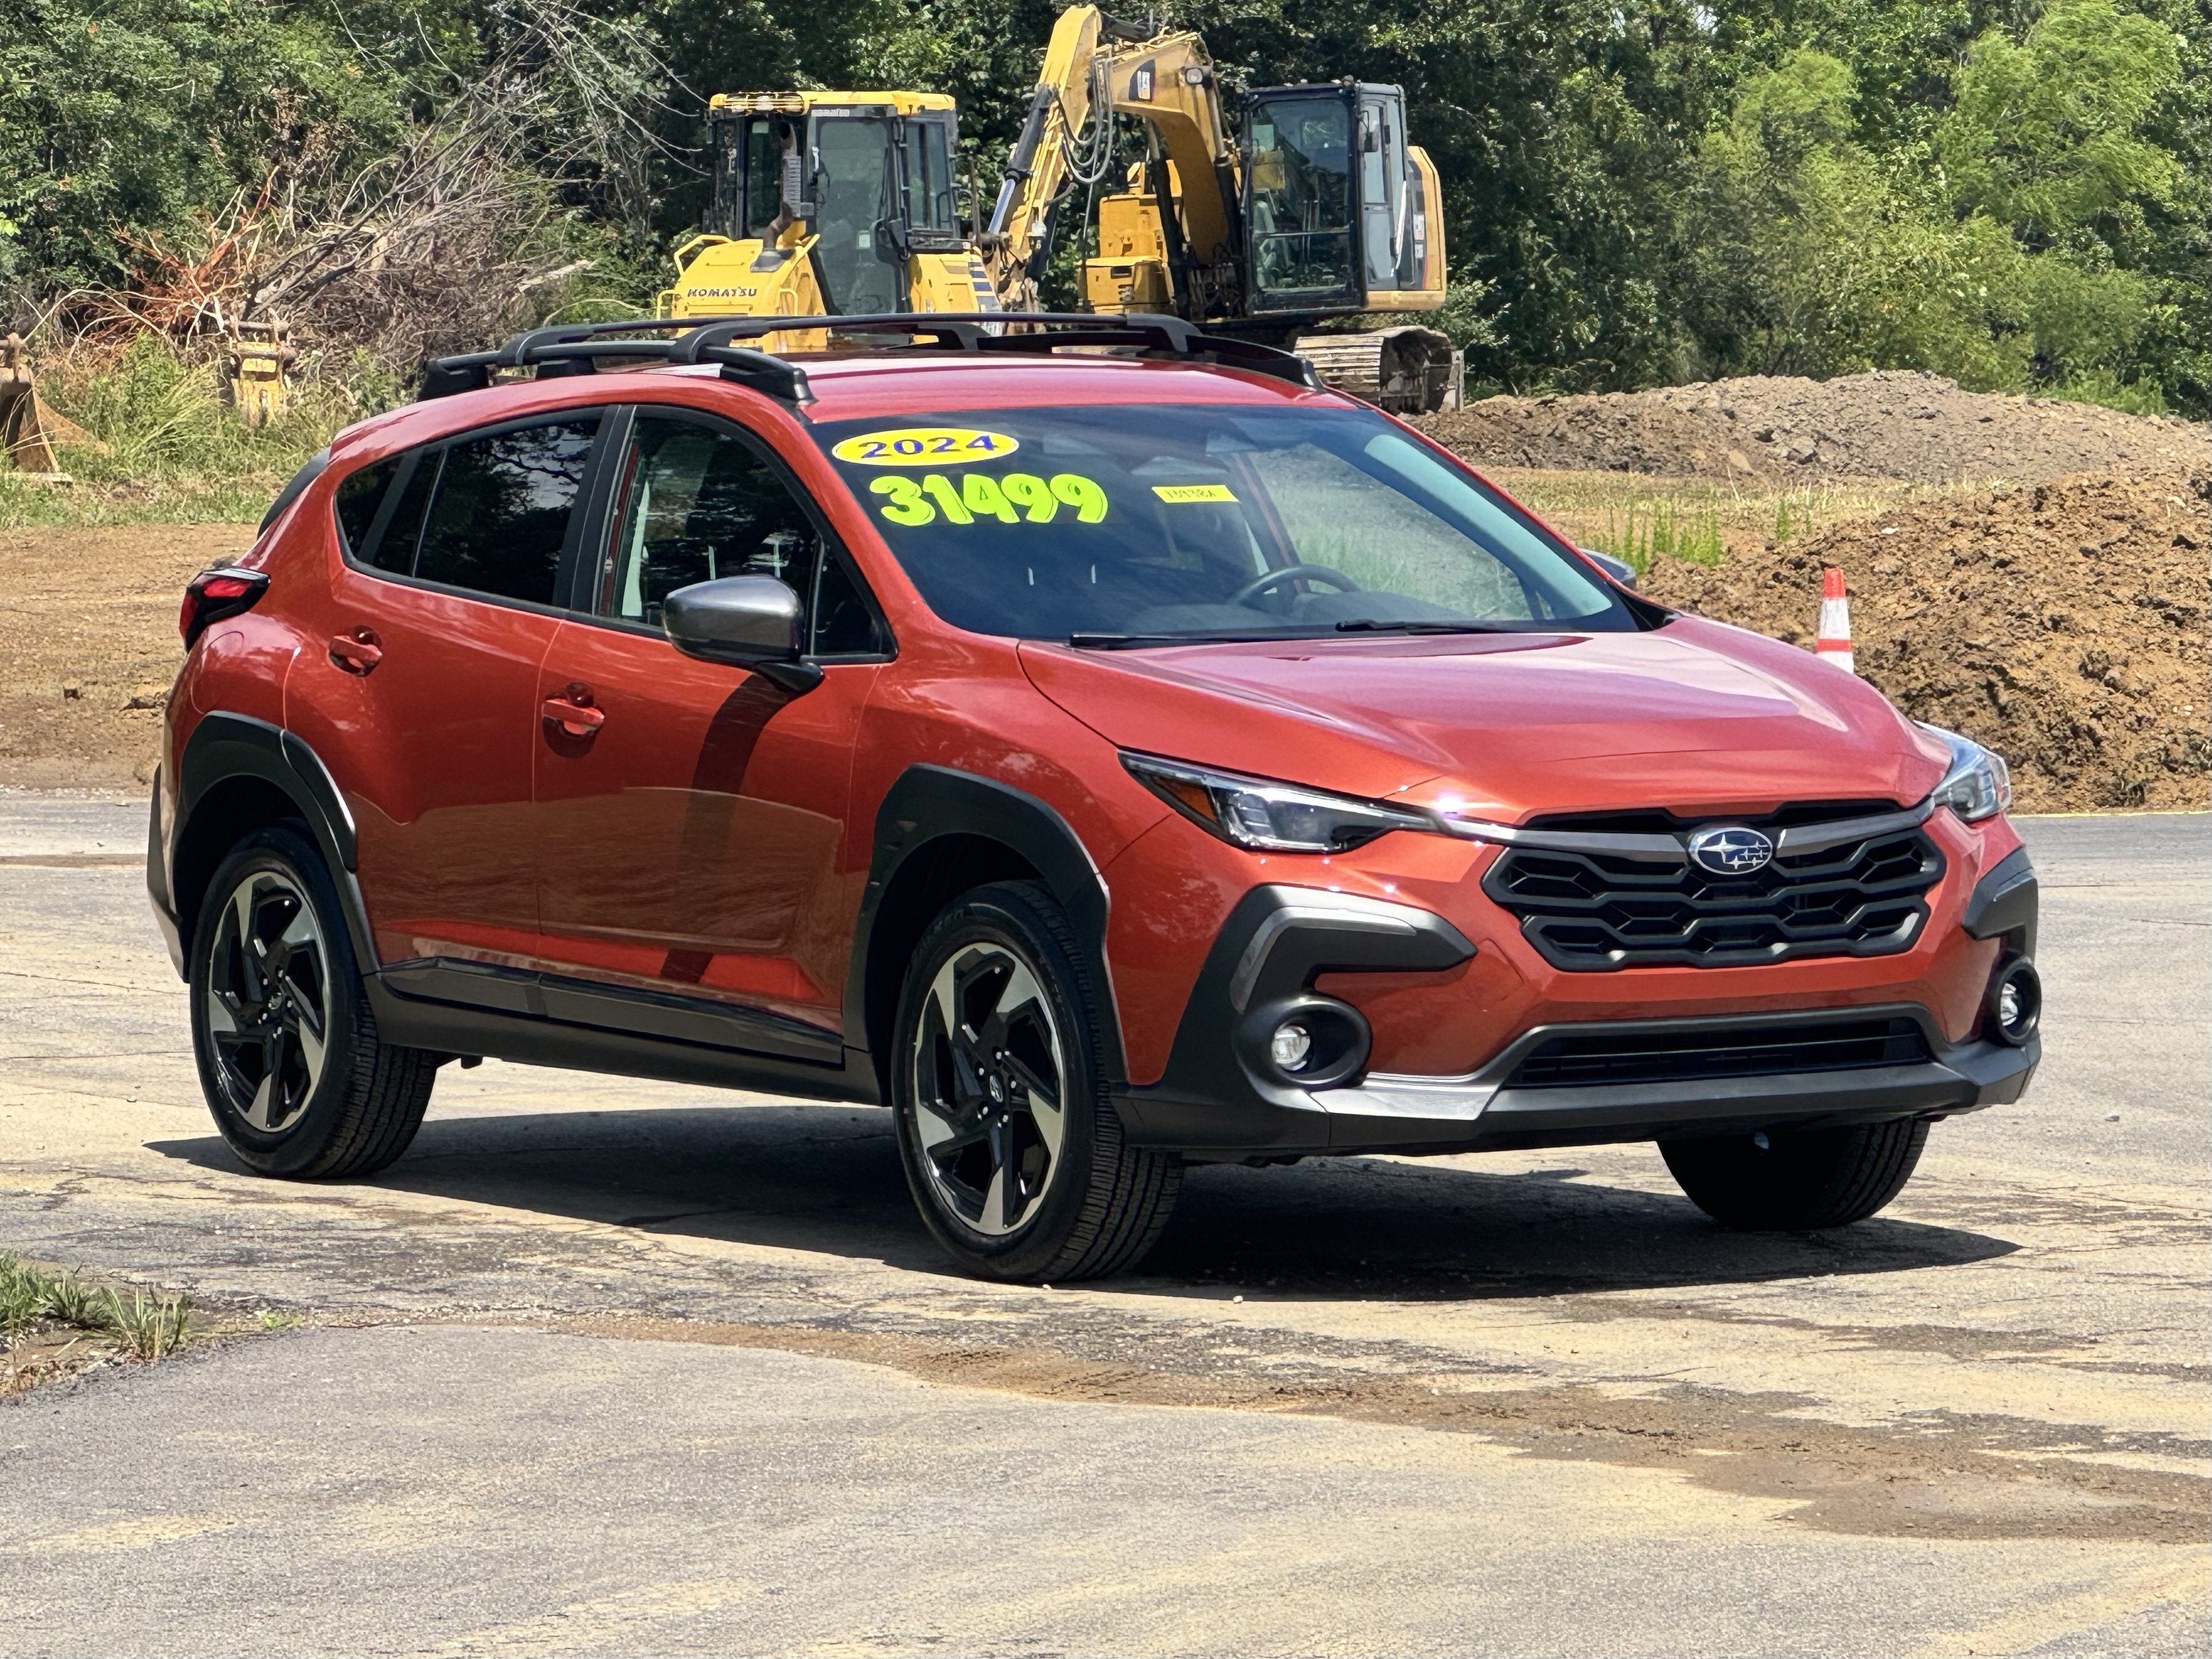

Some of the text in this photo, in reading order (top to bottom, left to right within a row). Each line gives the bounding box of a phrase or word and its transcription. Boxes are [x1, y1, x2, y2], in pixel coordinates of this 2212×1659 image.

[687, 288, 757, 298] KOMATSU
[858, 435, 998, 458] 2024
[869, 473, 1108, 526] 31499
